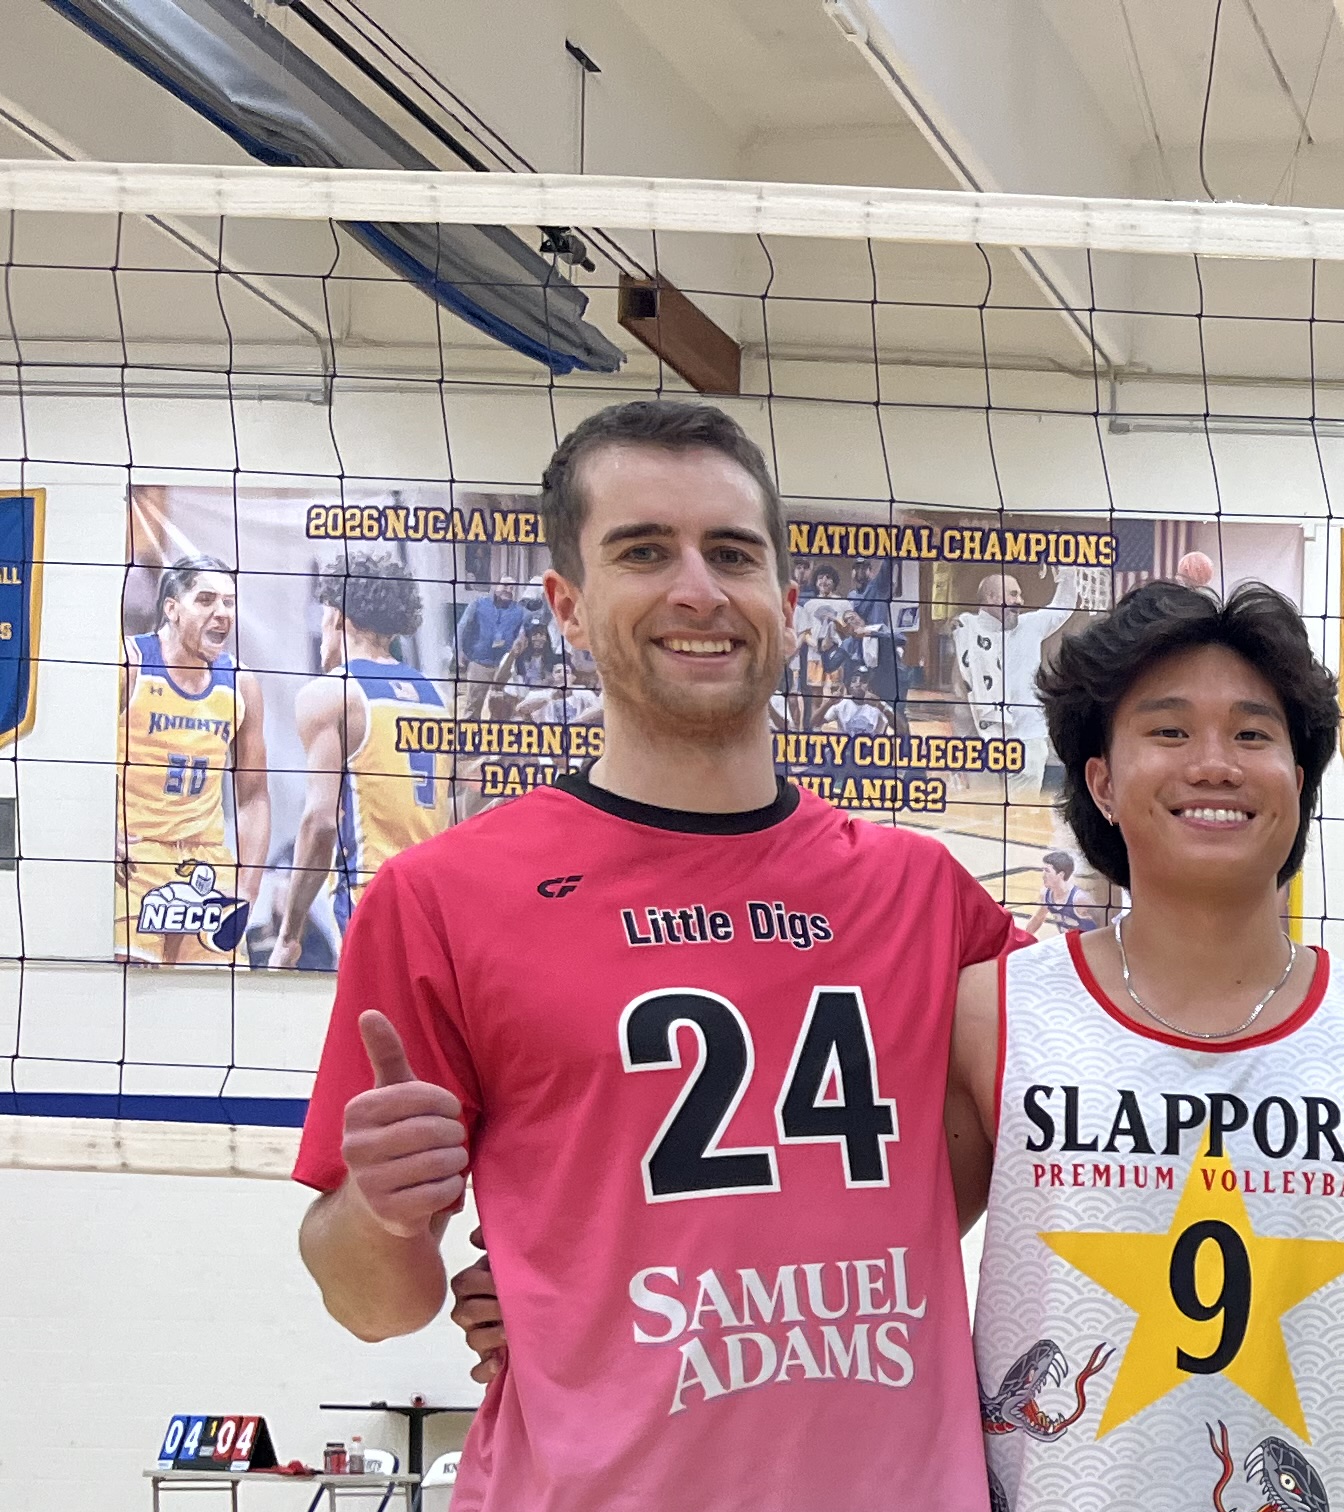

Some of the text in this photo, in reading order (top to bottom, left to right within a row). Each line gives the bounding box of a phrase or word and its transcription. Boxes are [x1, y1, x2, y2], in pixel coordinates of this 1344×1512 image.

[307, 505, 381, 539] 2026
[384, 506, 488, 543] NJCAA
[788, 523, 1117, 567] NATIONAL CHAMPIONS
[399, 720, 563, 755] NORTHERN
[853, 736, 983, 771] COLLEGE
[986, 738, 1024, 772] 68
[909, 779, 945, 810] 62
[142, 904, 221, 931] NECC
[621, 900, 833, 949] Little Digs
[618, 985, 900, 1204] 24
[1032, 1163, 1175, 1191] PREMIUM
[628, 1247, 928, 1345] SAMUEL
[1169, 1219, 1252, 1375] 9
[667, 1321, 915, 1416] ADAMS
